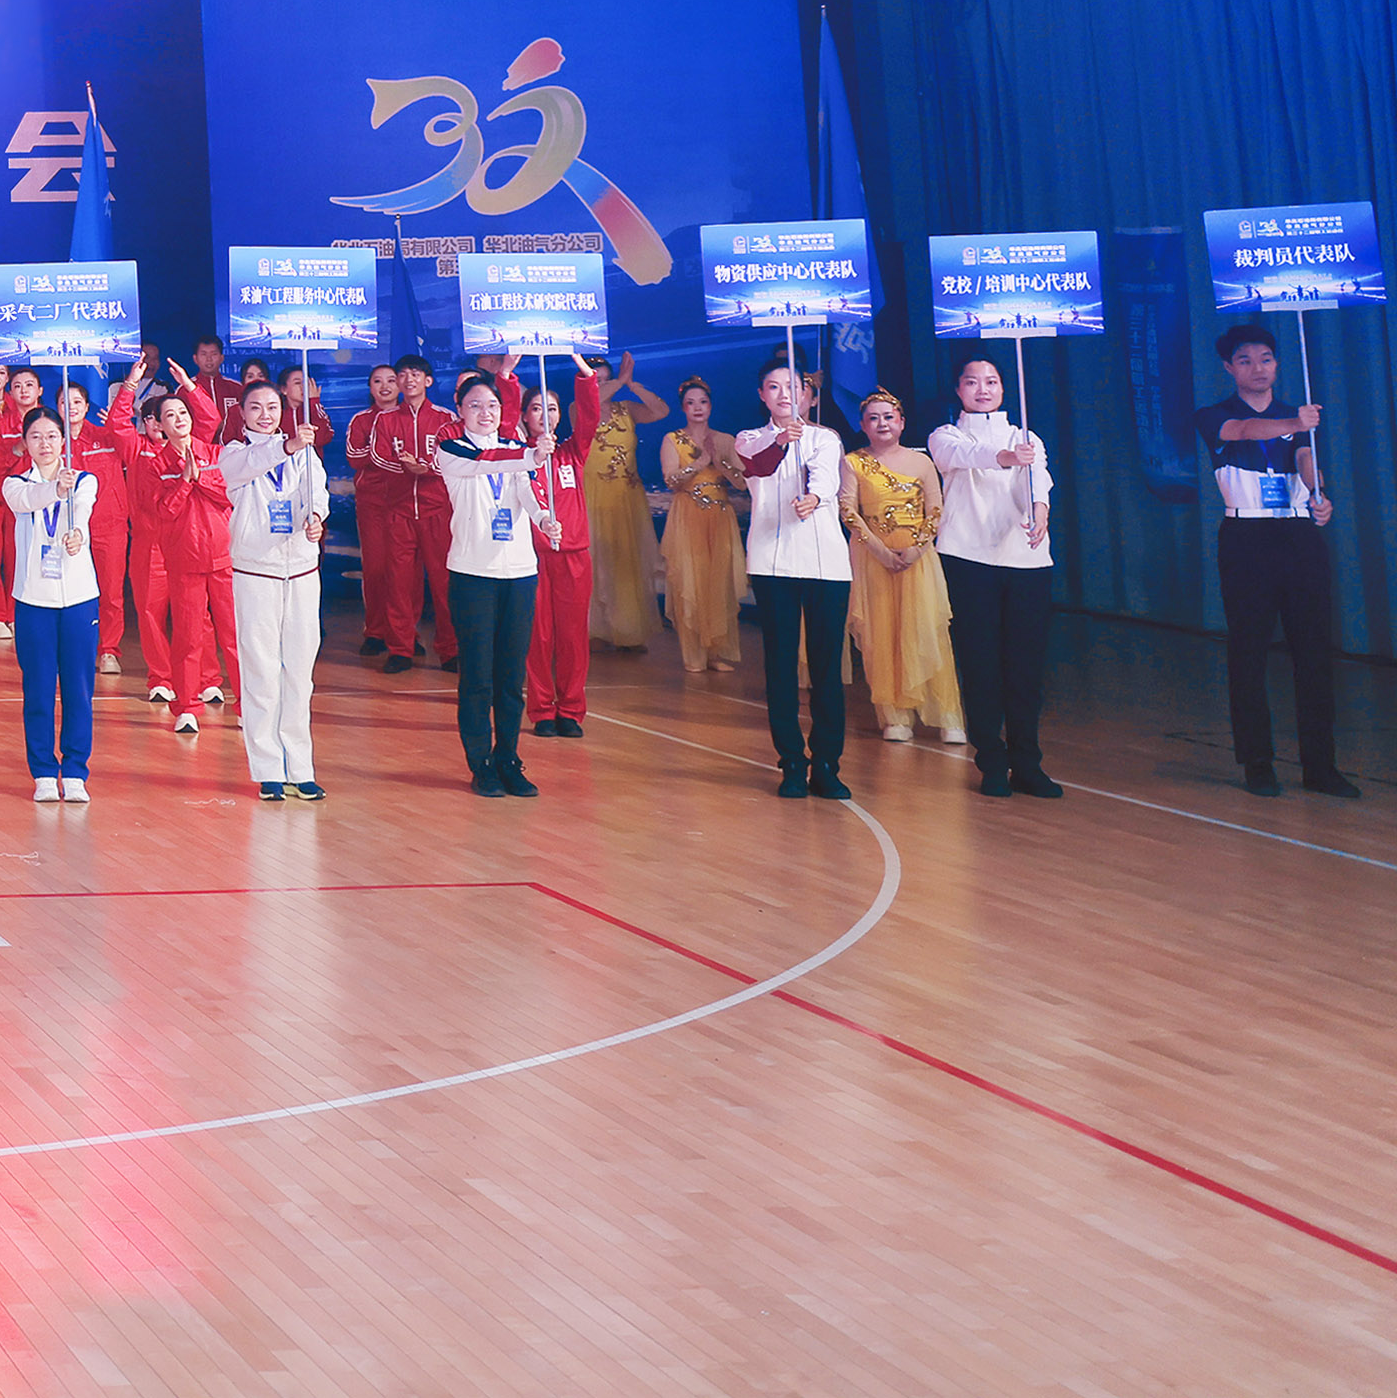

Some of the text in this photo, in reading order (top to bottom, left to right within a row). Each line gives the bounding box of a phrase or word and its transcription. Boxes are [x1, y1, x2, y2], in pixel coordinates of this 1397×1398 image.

[1233, 243, 1355, 268] 裁判员代表队
[714, 260, 857, 283] 物资供应中心代表队
[0, 301, 127, 322] 采气二厂代表队
